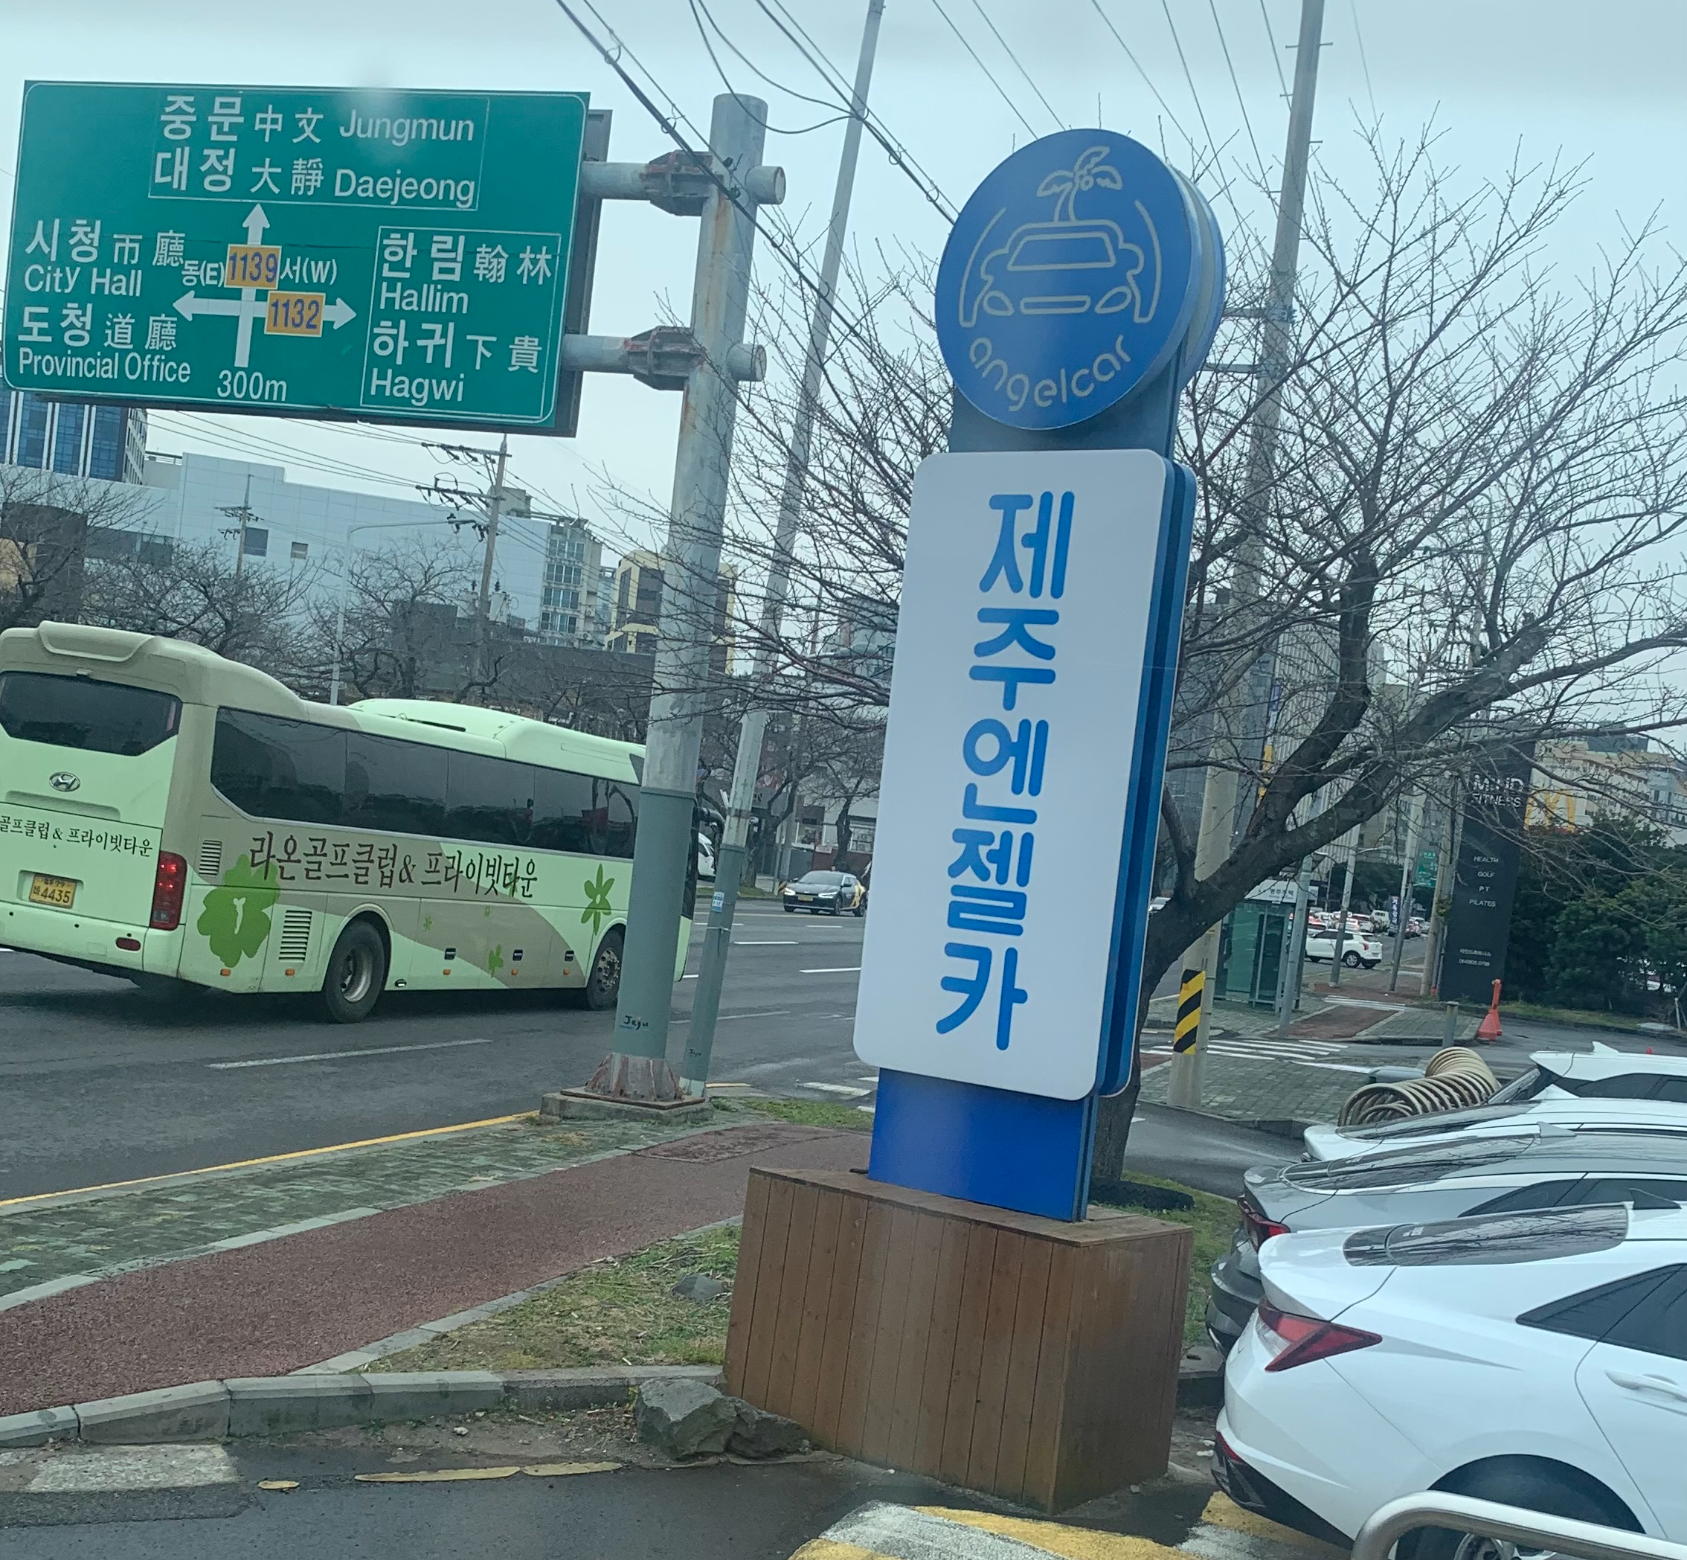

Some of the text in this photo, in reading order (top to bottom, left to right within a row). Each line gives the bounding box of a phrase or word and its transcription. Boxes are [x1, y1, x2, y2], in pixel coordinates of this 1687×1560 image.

[159, 94, 476, 148] 중문 中文 Jungmun
[153, 145, 477, 209] 대정 大靜 Daejeong
[25, 218, 187, 268] 시청 市廳
[382, 231, 553, 286] 한림 翰林
[24, 263, 144, 297] City Hall
[181, 251, 338, 289] 동(E) 1139 서(W)
[270, 297, 320, 330] 1132
[379, 281, 470, 315] Hallim
[17, 302, 179, 352] 도청 道廳
[372, 318, 543, 374] 하귀 下貴
[18, 346, 192, 384] Provincial Office
[969, 334, 1131, 412] angelcar
[216, 369, 288, 402] 300m
[369, 367, 466, 407] Hagwi
[935, 489, 1076, 1052] 제주엔젤카
[52, 827, 63, 841] &
[66, 827, 153, 857] 프라이빗타운
[1473, 855, 1499, 863] HEALTH
[420, 849, 538, 898] 프라이빗타운
[40, 887, 72, 904] 4435
[1469, 898, 1496, 907] PILATES
